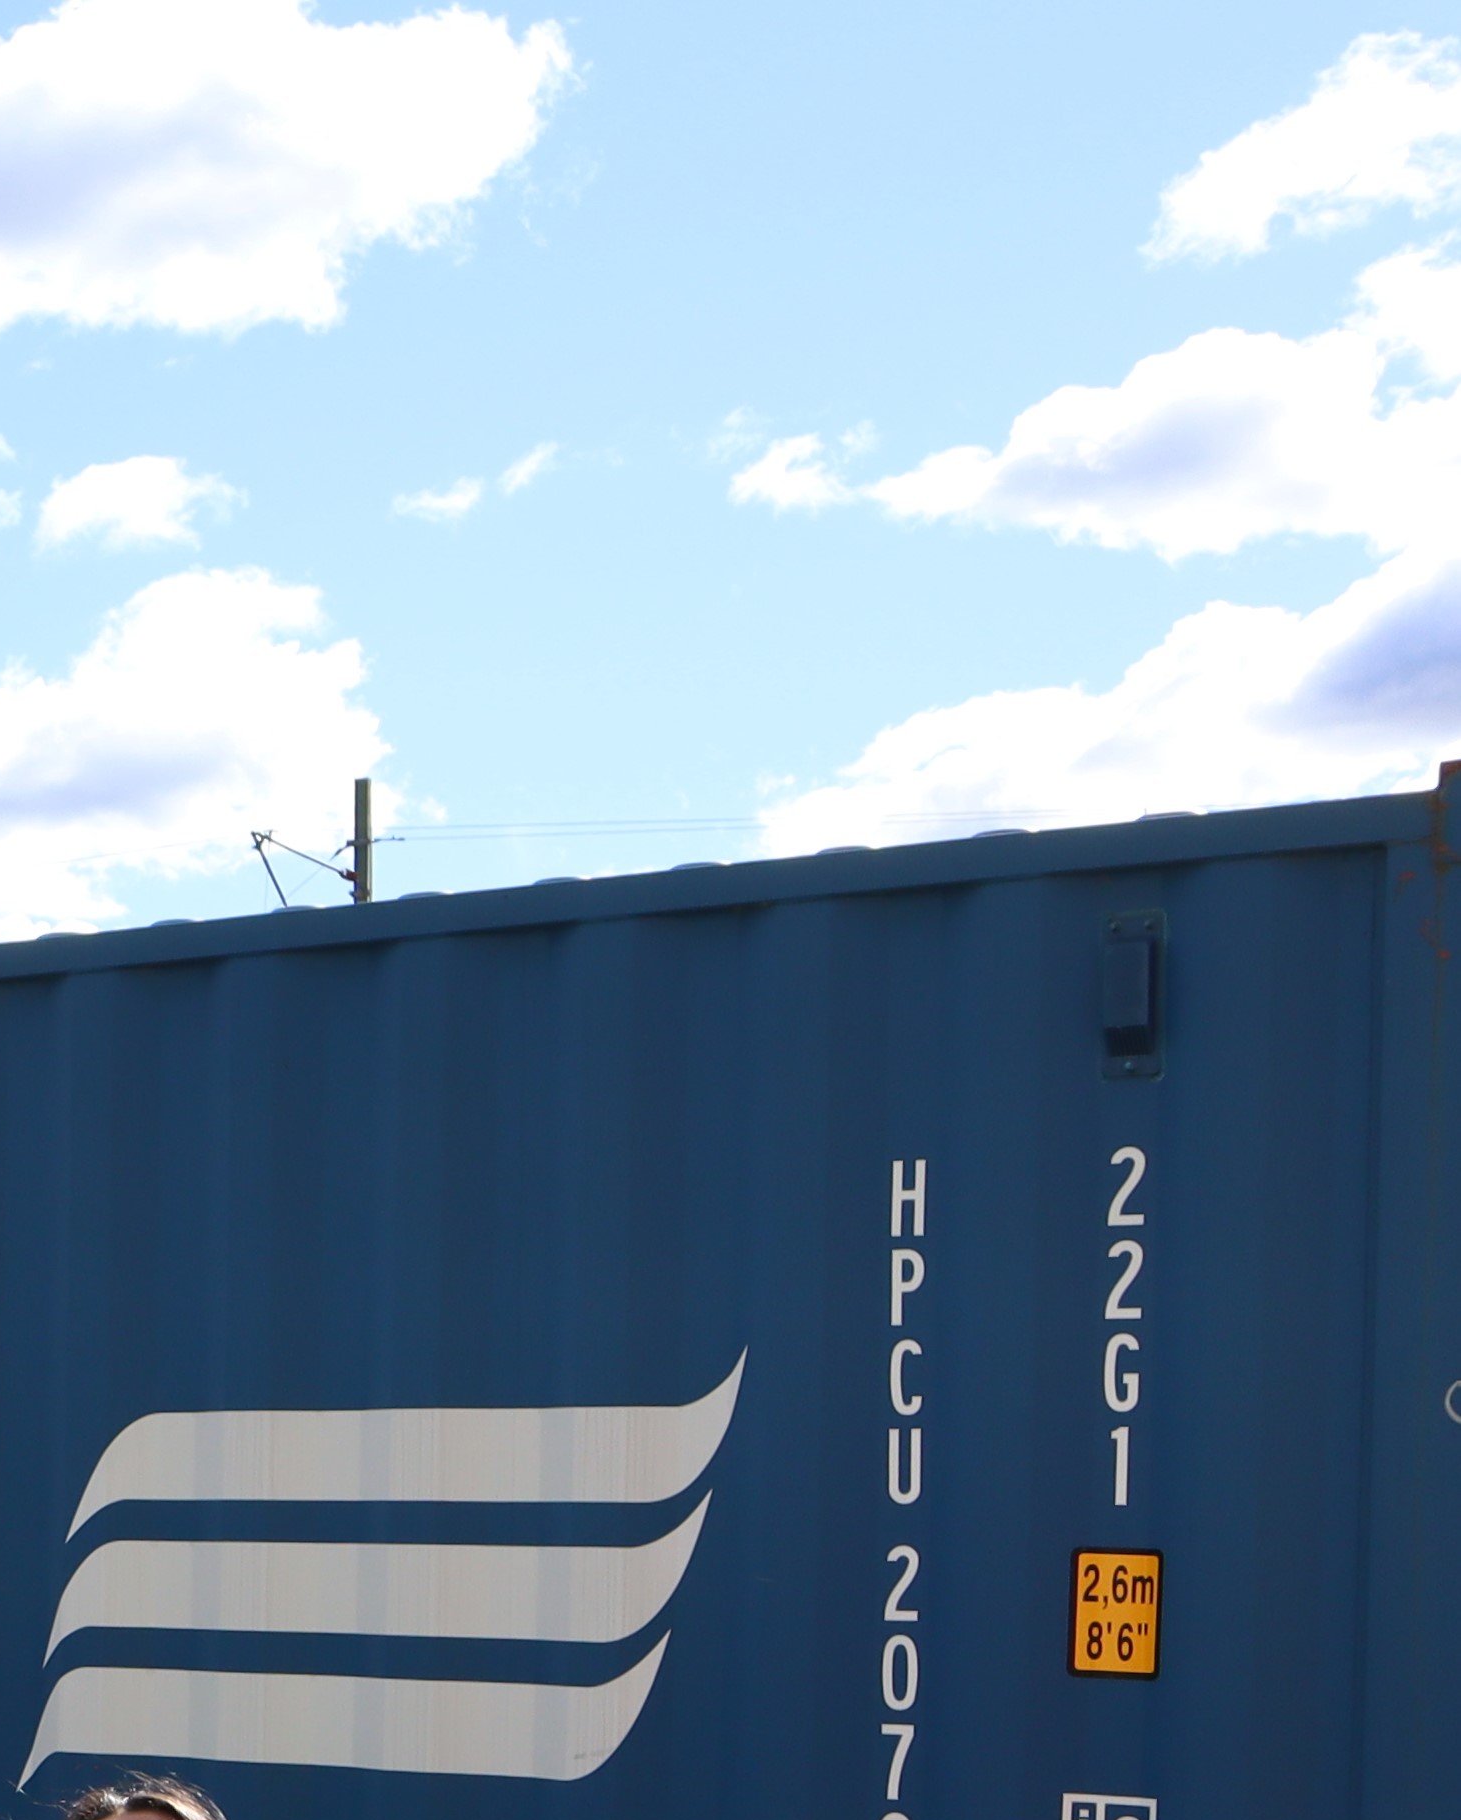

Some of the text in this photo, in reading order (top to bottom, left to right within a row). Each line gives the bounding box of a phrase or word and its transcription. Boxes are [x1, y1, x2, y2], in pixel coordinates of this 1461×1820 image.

[888, 1159, 927, 1505] HPCU
[1104, 1146, 1146, 1506] 22G1
[1082, 1563, 1154, 1609] 2,6m
